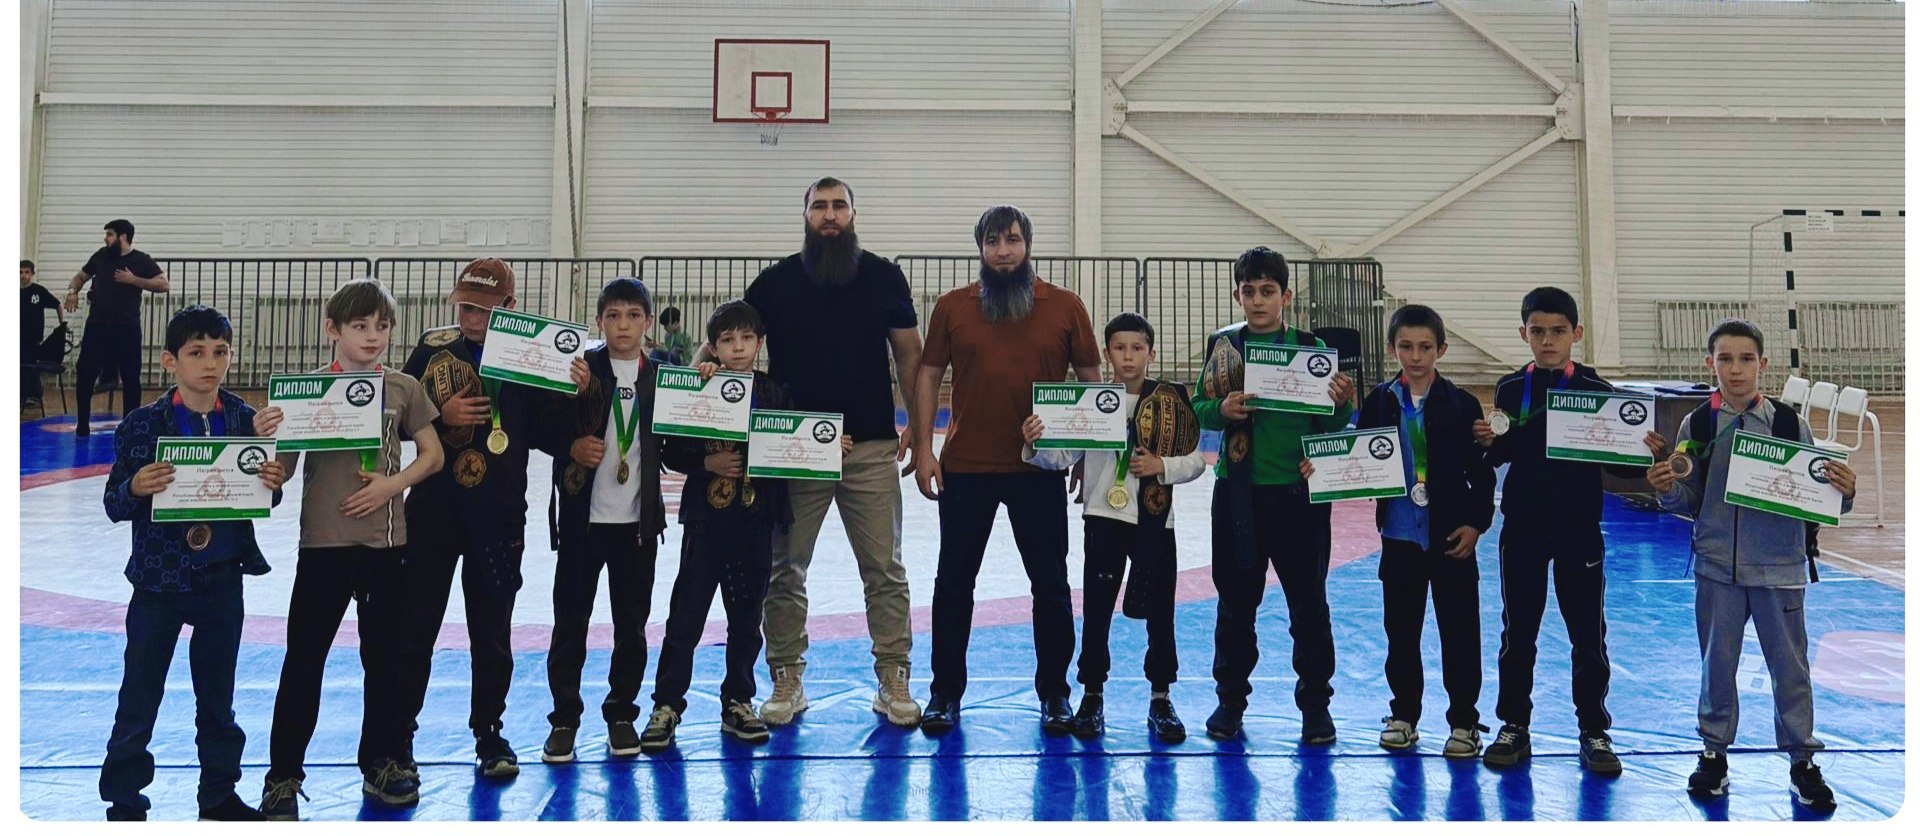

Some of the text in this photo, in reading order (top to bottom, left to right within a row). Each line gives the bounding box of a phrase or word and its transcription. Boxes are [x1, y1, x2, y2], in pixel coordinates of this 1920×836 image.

[493, 315, 537, 335] ДИПЛОМ
[1249, 348, 1288, 363] ДИПЛОМ
[661, 372, 702, 388] ДИПЛОМ
[274, 381, 323, 397] ДИПЛОМ
[1037, 389, 1077, 403] ДИПЛОМ
[1551, 395, 1597, 410] ДИПЛОМ
[754, 416, 794, 431] ДИПЛОМ
[161, 446, 213, 462] ДИПЛОМ
[1308, 439, 1348, 456] ДИПЛОМ
[1737, 439, 1786, 461] ДИПЛОМ
